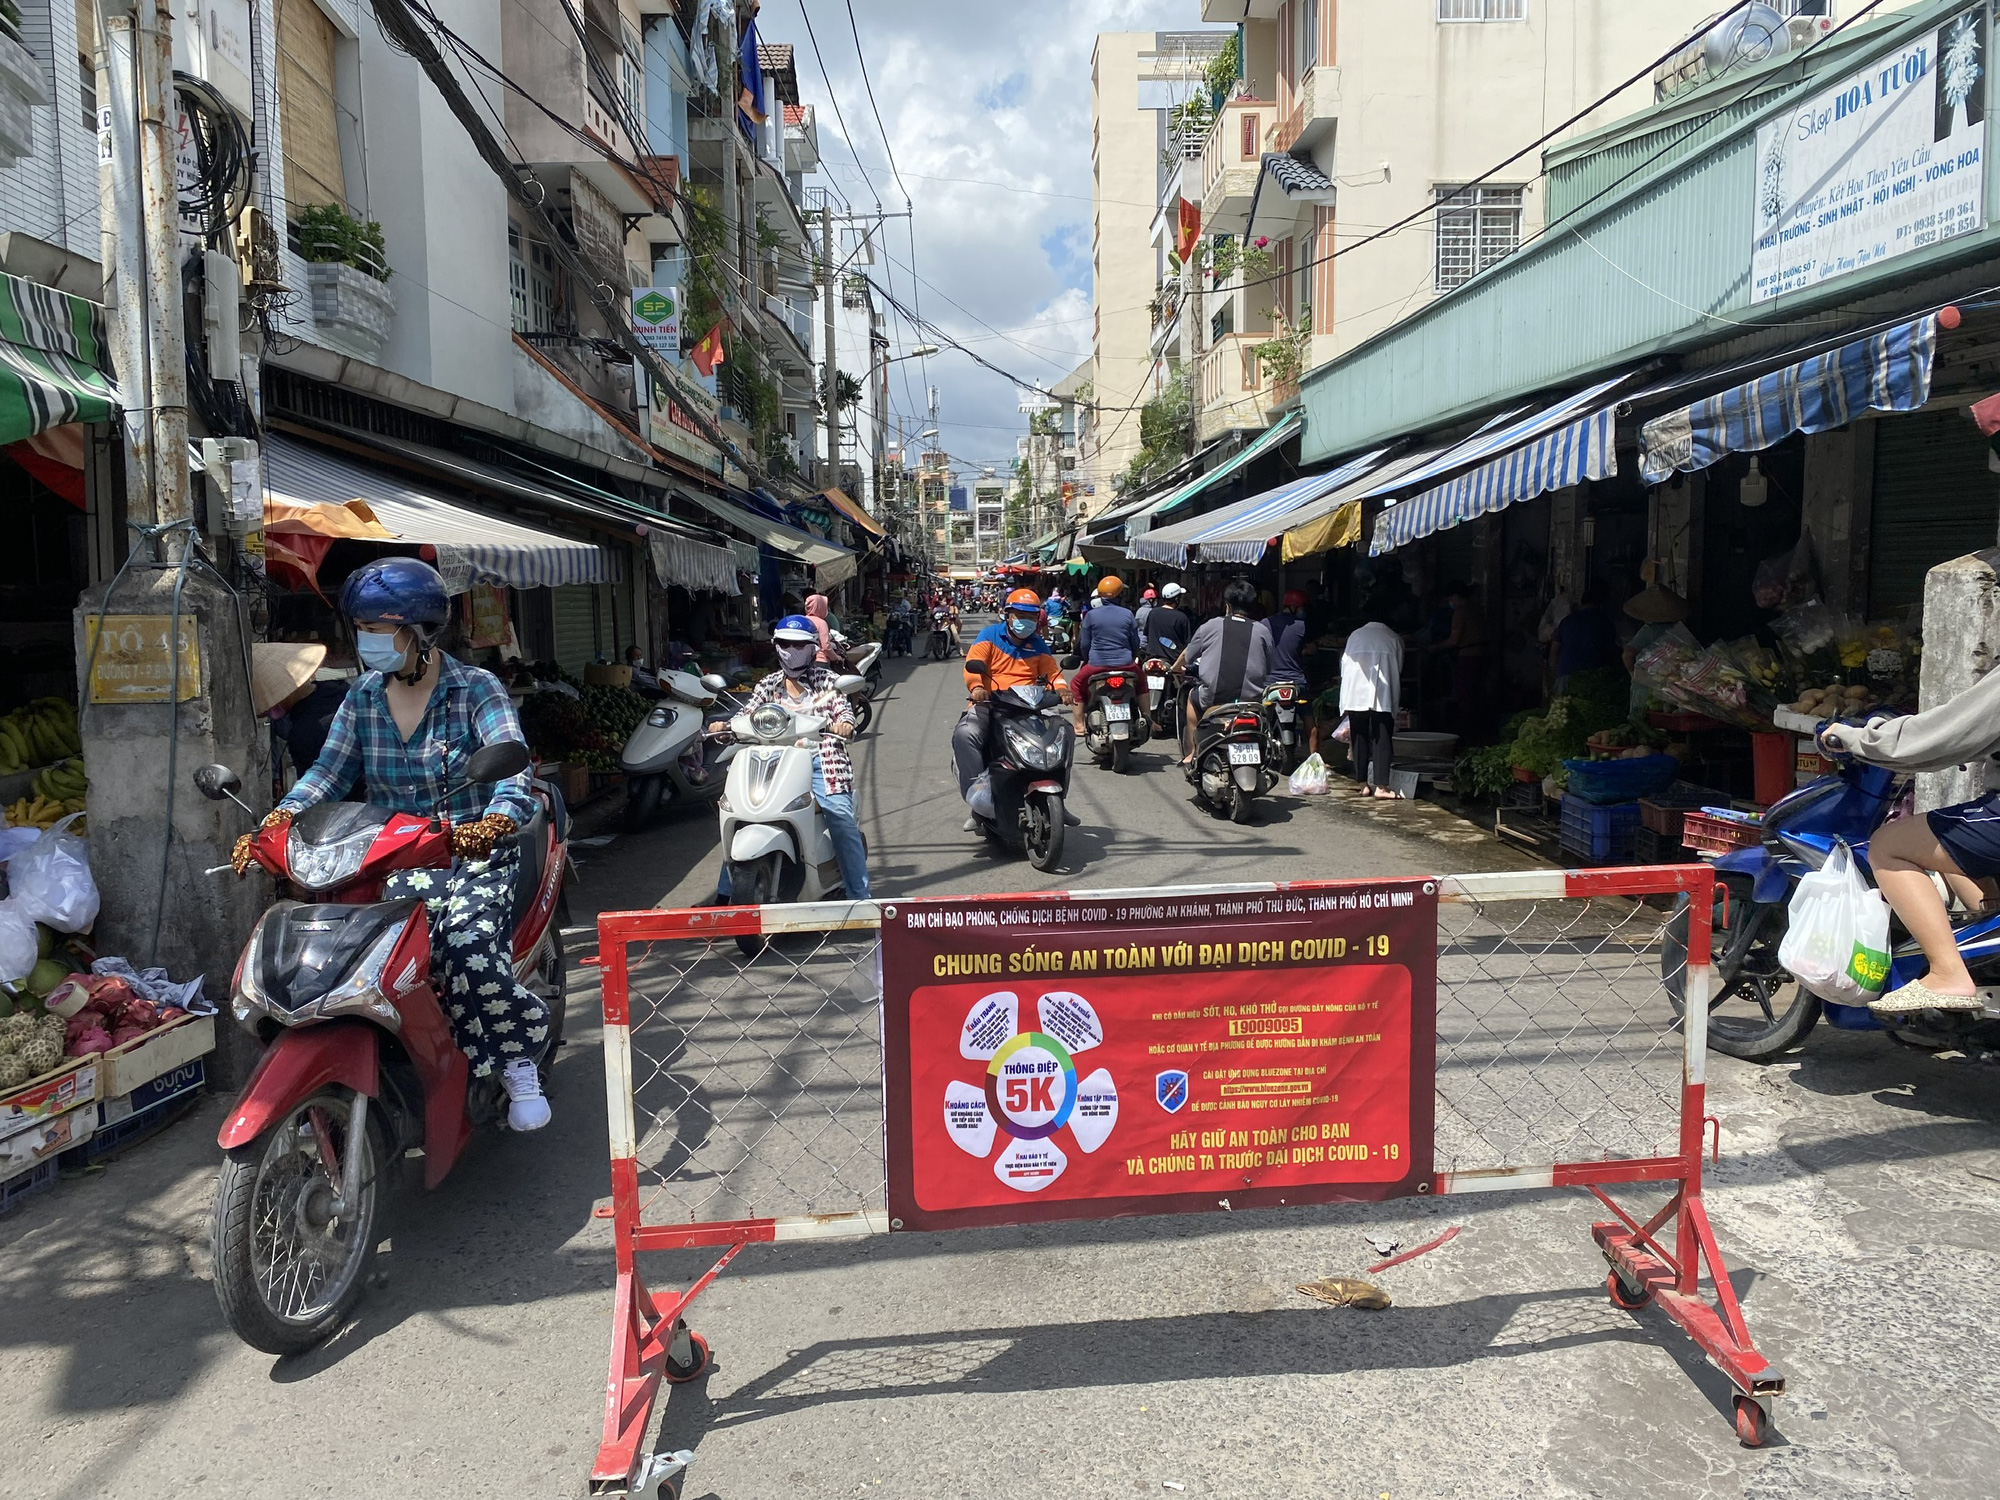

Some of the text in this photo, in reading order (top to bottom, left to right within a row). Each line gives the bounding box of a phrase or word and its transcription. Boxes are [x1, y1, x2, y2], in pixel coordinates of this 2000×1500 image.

[1797, 47, 1928, 141] Shop HOA TƯƠI
[1846, 177, 1864, 197] Hoa
[1866, 168, 1888, 194] Theo
[1891, 157, 1909, 178] Yêu
[1912, 143, 1931, 168] Cầu
[1759, 233, 1777, 251] KHAI
[1818, 208, 1838, 228] SINH
[1840, 197, 1864, 219] NHẬT
[1873, 185, 1889, 206] HỘI
[1892, 175, 1916, 198] NGHỊ
[1926, 162, 1954, 182] VÒNG
[1957, 148, 1979, 170] HOA
[1913, 214, 1936, 233] 0938
[1957, 200, 1974, 217] 364
[1914, 230, 1936, 247] 0932
[1957, 215, 1976, 232] 850
[1803, 259, 1812, 273] SỐ
[1812, 260, 1816, 269] 7
[1784, 280, 1793, 291] AN
[1796, 276, 1807, 288] Q.2
[643, 302, 666, 312] SP
[632, 323, 677, 334] MINH TIẾN
[100, 622, 144, 654] TỔ
[97, 662, 138, 680] ĐƯỜNG 7
[907, 889, 1413, 930] BAN CHỈ ĐẠO PHÒNG, CHỐNG DỊCH BỆNH COVID 19 PHƯỜNG AN KHÁNH, THÀNH PHỐ THỦ ĐỨC, THÀNH PHỐ HỒ CHÍ MINH
[933, 934, 1390, 977] CHUNG SỐNG AN TOÀN VỚI ĐẠI DỊCH COVID 19
[395, 979, 426, 1000] HONDA
[980, 1001, 997, 1020] TRANG
[1163, 1011, 1173, 1020] CÓ
[1202, 1003, 1221, 1018] SỐT,
[1223, 1005, 1238, 1017] HO,
[1240, 1002, 1258, 1016] KHÓ
[1260, 1000, 1277, 1014] THỞ
[1232, 1018, 1299, 1035] 19009095
[1176, 1043, 1193, 1053] QUAN
[1194, 1042, 1199, 1052] Y
[1199, 1040, 1208, 1052] TẾ
[1355, 1035, 1364, 1043] AN
[1004, 1060, 1059, 1075] THÔNG ĐIỆP
[1260, 1067, 1292, 1077] BLUEZONE
[1005, 1076, 1056, 1113] 5K
[1102, 1094, 1117, 1102] TRUNG
[1251, 1099, 1268, 1109] NGUY
[1312, 1094, 1339, 1105] COVID-19
[970, 1100, 986, 1109] CÁCH
[1170, 1122, 1350, 1150] HÃY GIỮ AN TOÀN CHO BẠN
[1126, 1143, 1399, 1176] VÀ CHÚNG TA TRƯỚC ĐẠI DỊCH COVID 19
